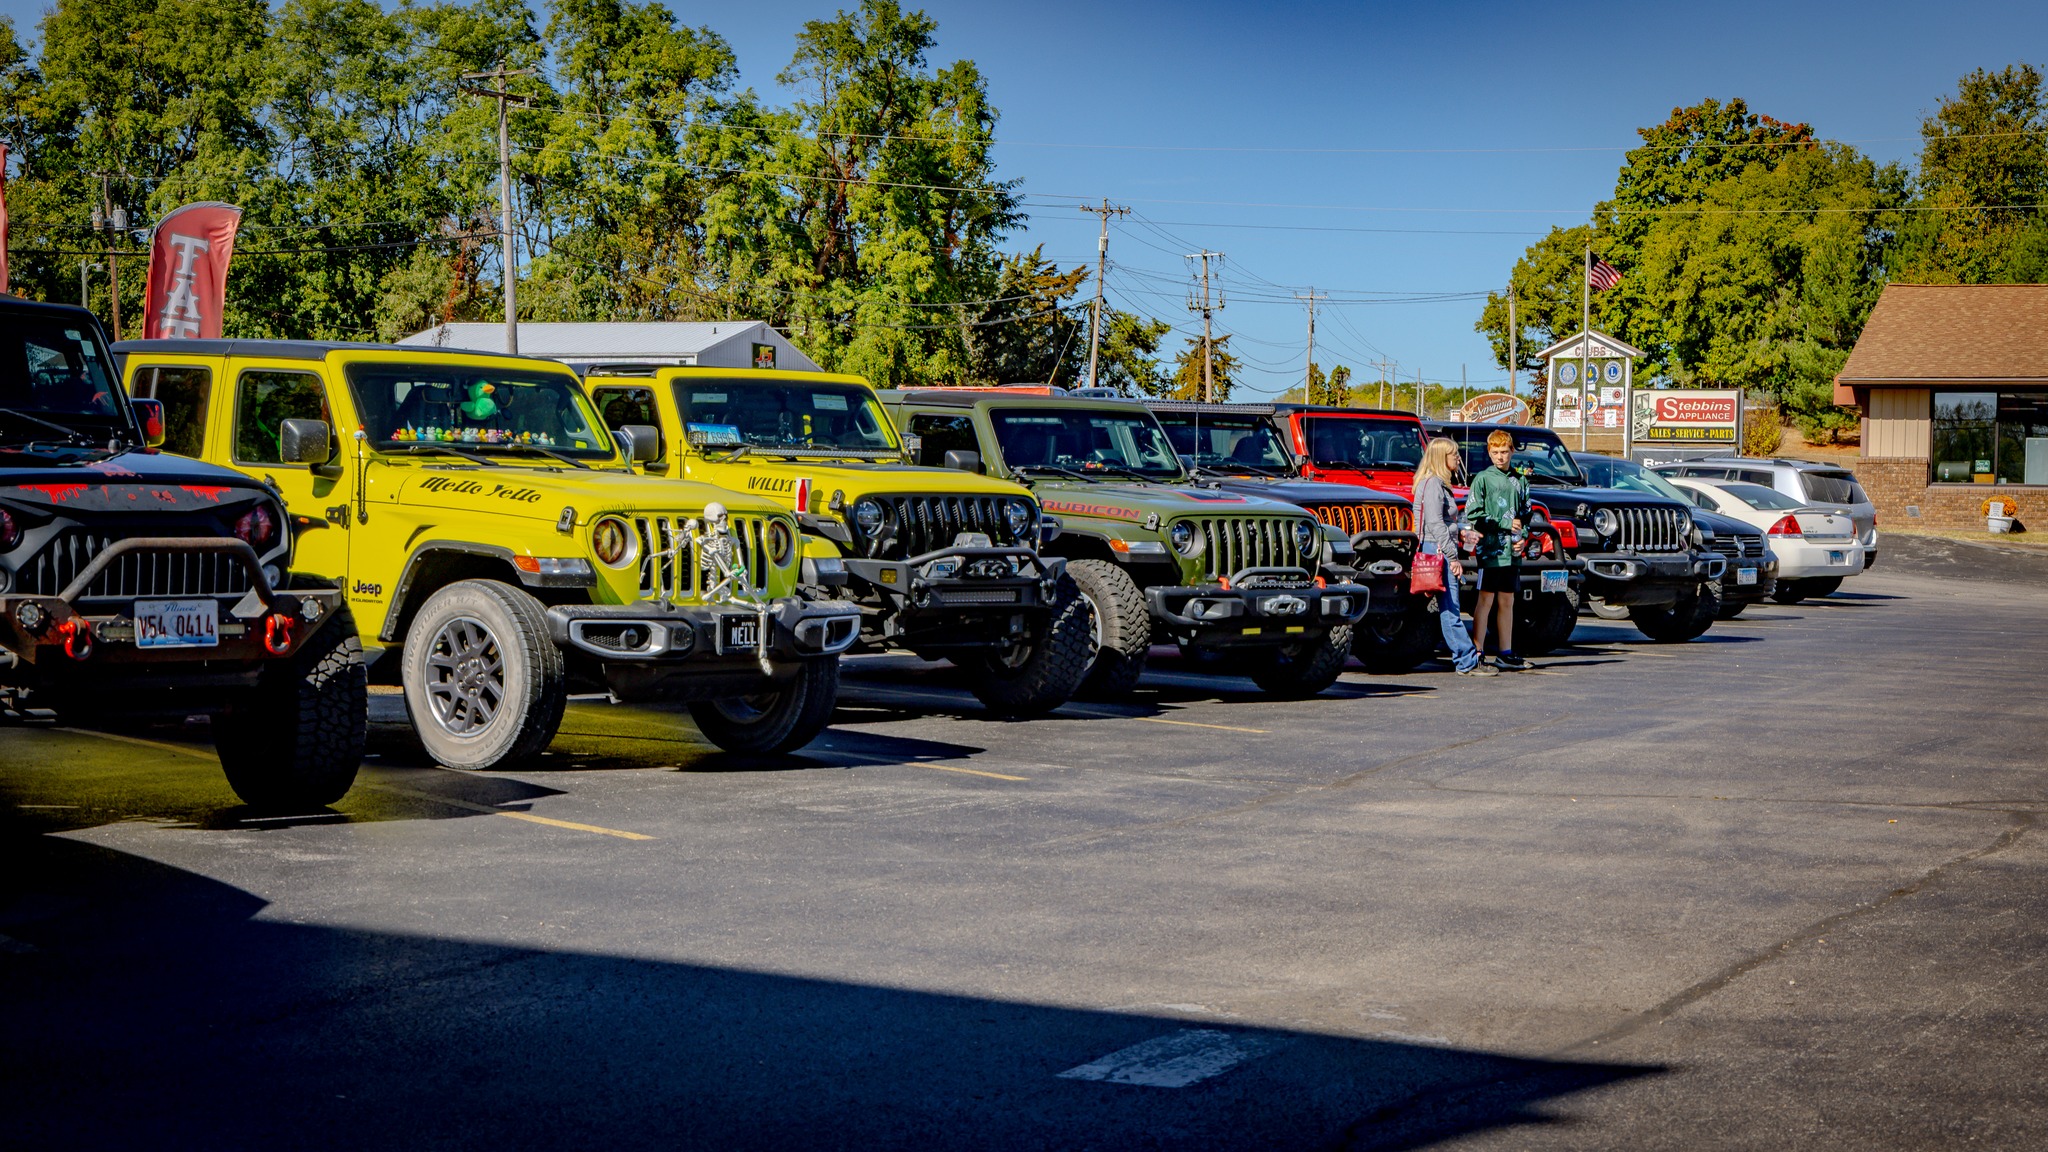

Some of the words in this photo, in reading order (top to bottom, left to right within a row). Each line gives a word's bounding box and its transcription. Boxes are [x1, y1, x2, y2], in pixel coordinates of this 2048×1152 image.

[1663, 398, 1731, 419] Stebbins
[1678, 412, 1730, 420] APPLIANCE
[1650, 428, 1671, 438] SALES
[1675, 428, 1705, 439] SERVICE
[1709, 429, 1734, 439] PARTS
[420, 476, 483, 495] Mello
[486, 484, 542, 503] Yello
[1042, 500, 1141, 520] RUBICON
[352, 579, 383, 597] Jeep
[164, 603, 197, 612] Illinois
[139, 614, 168, 640] V54
[176, 613, 215, 637] 0414
